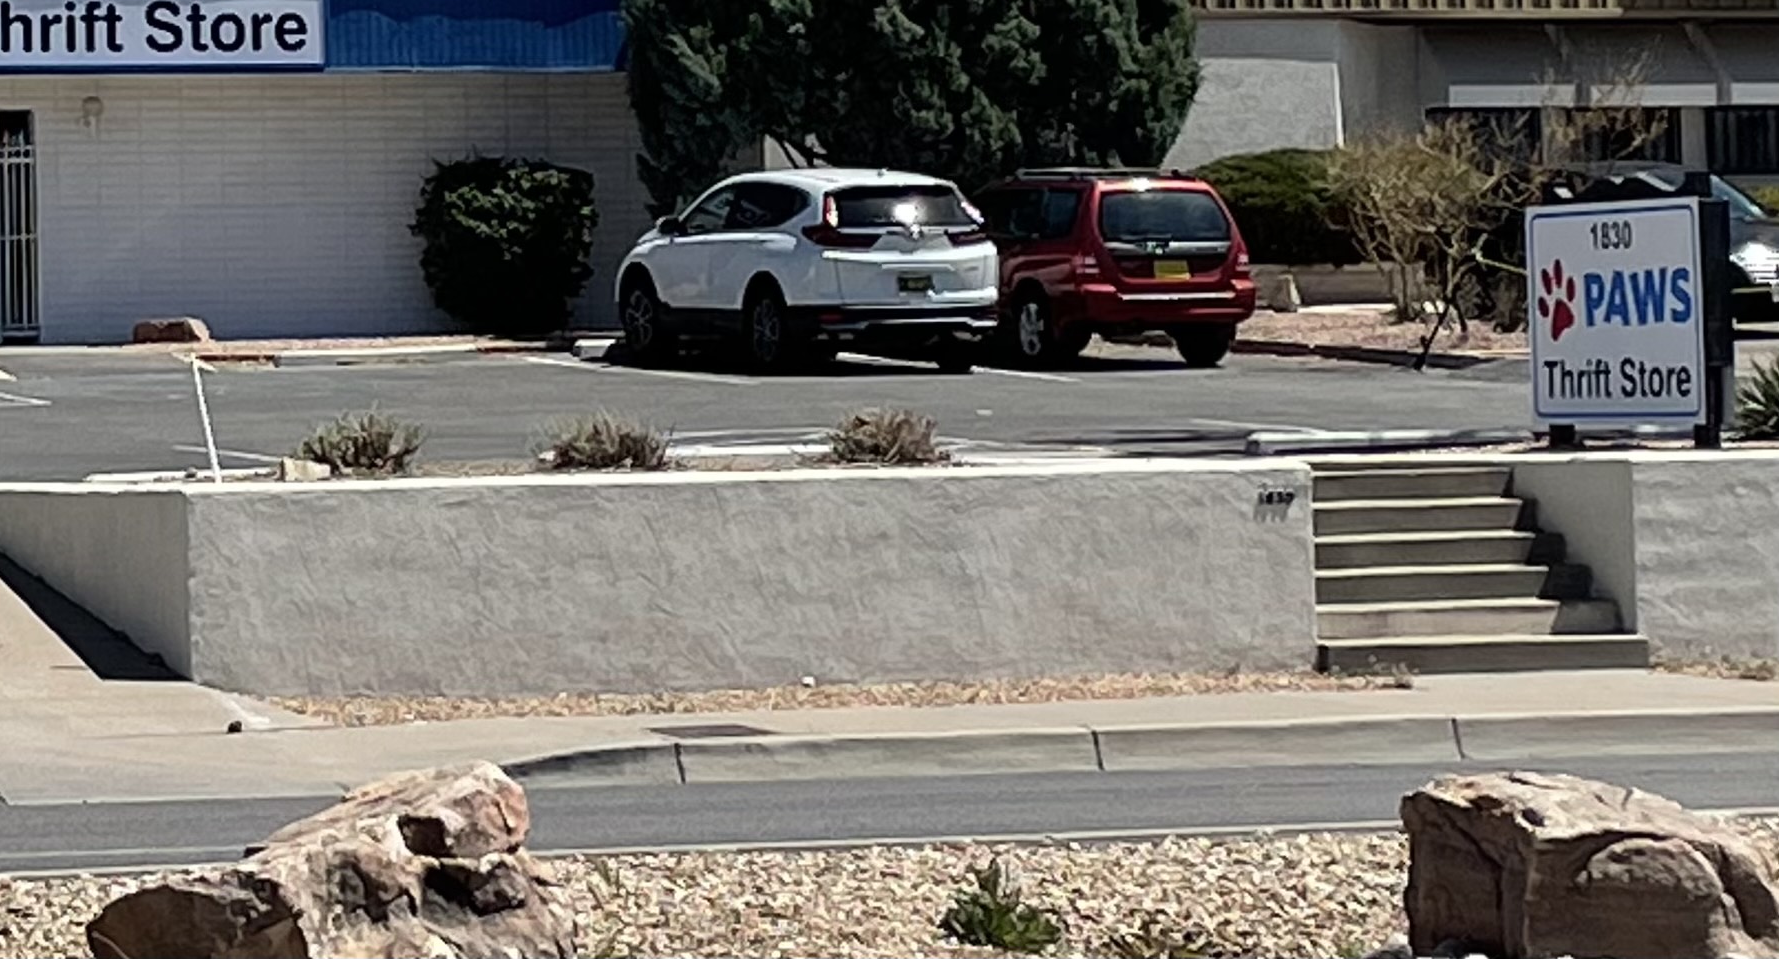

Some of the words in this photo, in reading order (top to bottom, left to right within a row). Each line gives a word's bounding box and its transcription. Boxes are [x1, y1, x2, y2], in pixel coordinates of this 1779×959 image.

[144, 0, 308, 54] Store
[1590, 220, 1632, 250] 1830
[1583, 266, 1692, 328] PAWS
[1543, 357, 1613, 400] Thrift
[1620, 356, 1692, 398] Store
